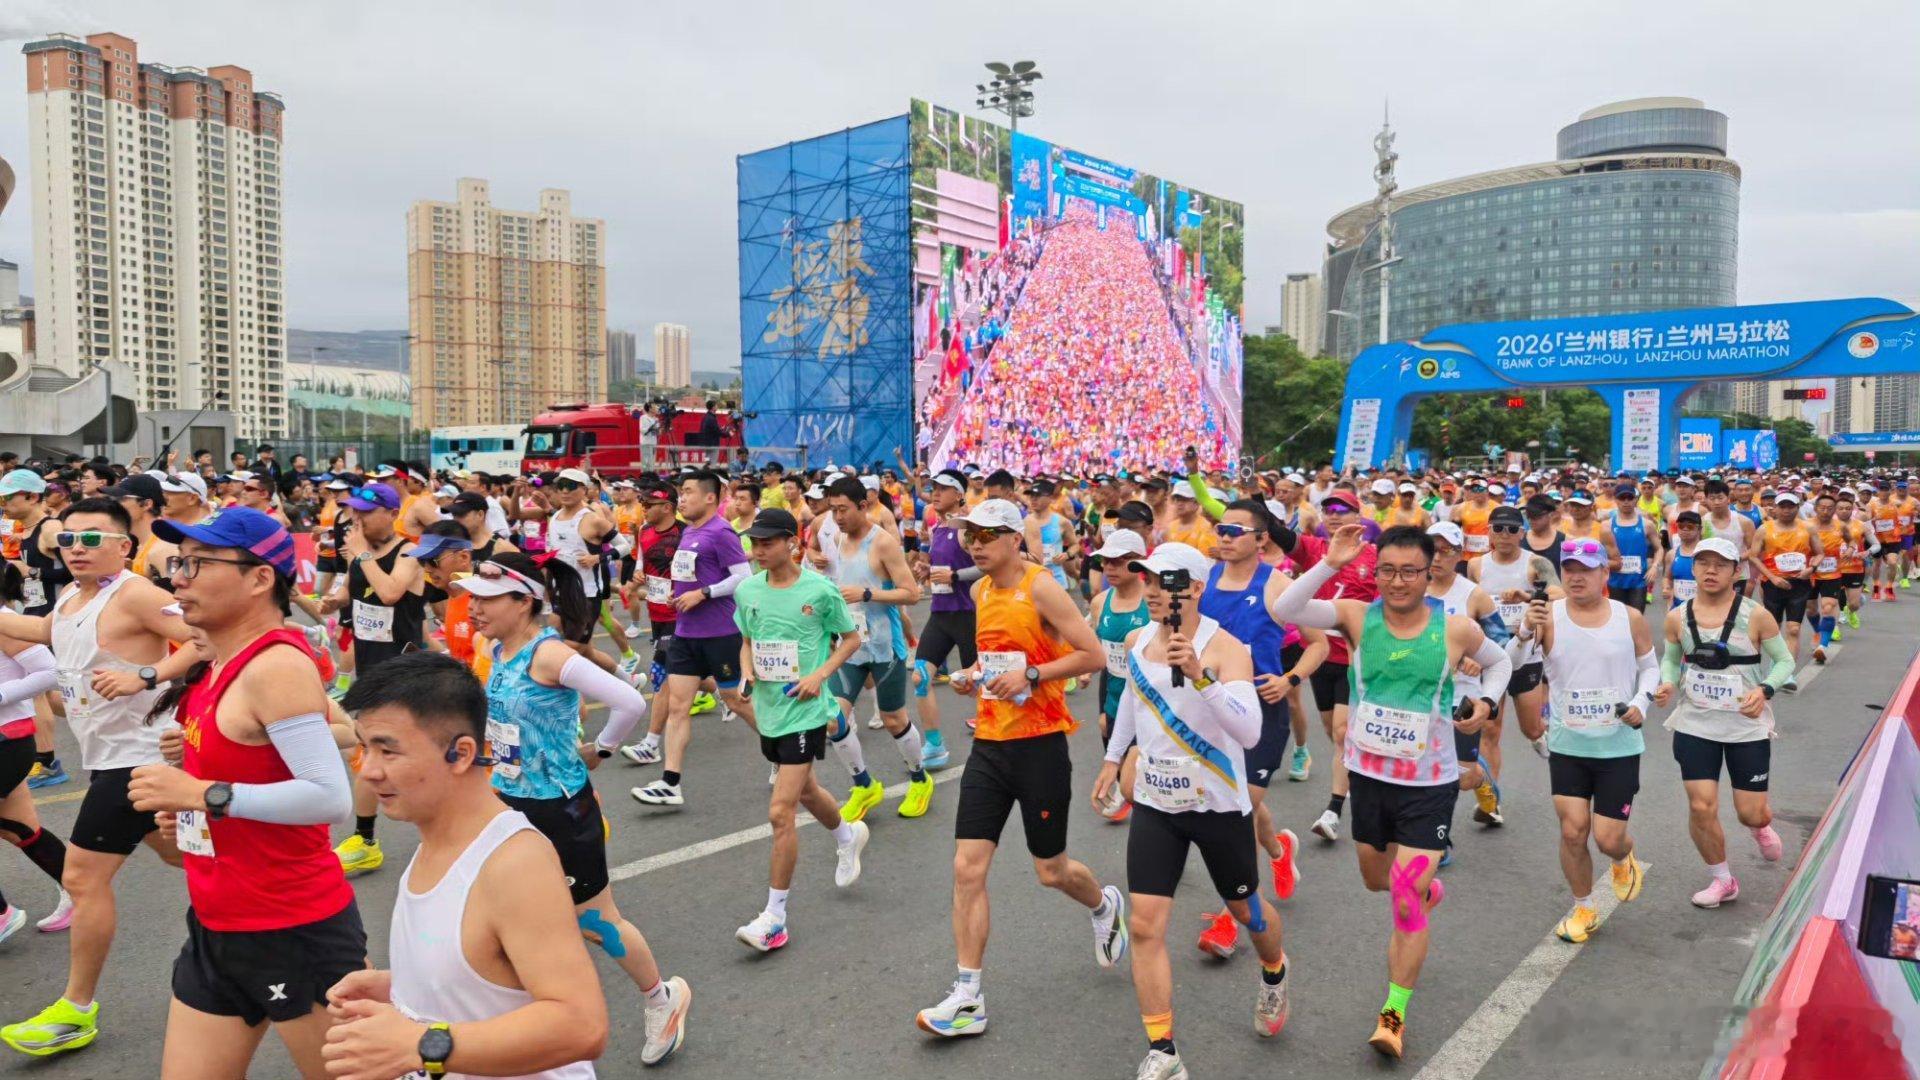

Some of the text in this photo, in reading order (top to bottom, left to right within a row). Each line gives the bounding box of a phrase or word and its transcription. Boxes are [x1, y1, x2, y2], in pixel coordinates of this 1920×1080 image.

[1497, 319, 1790, 356] 2026「兰州银行」兰州马拉松
[1538, 356, 1555, 367] OF
[1635, 349, 1702, 363] LANZHOU
[1707, 344, 1790, 359] MARATHON
[1693, 684, 1732, 697] C11171
[1131, 663, 1215, 759] SUNSET TRACK
[1568, 703, 1611, 715] B31569
[1365, 721, 1416, 741] C21246
[1144, 771, 1190, 789] B26480
